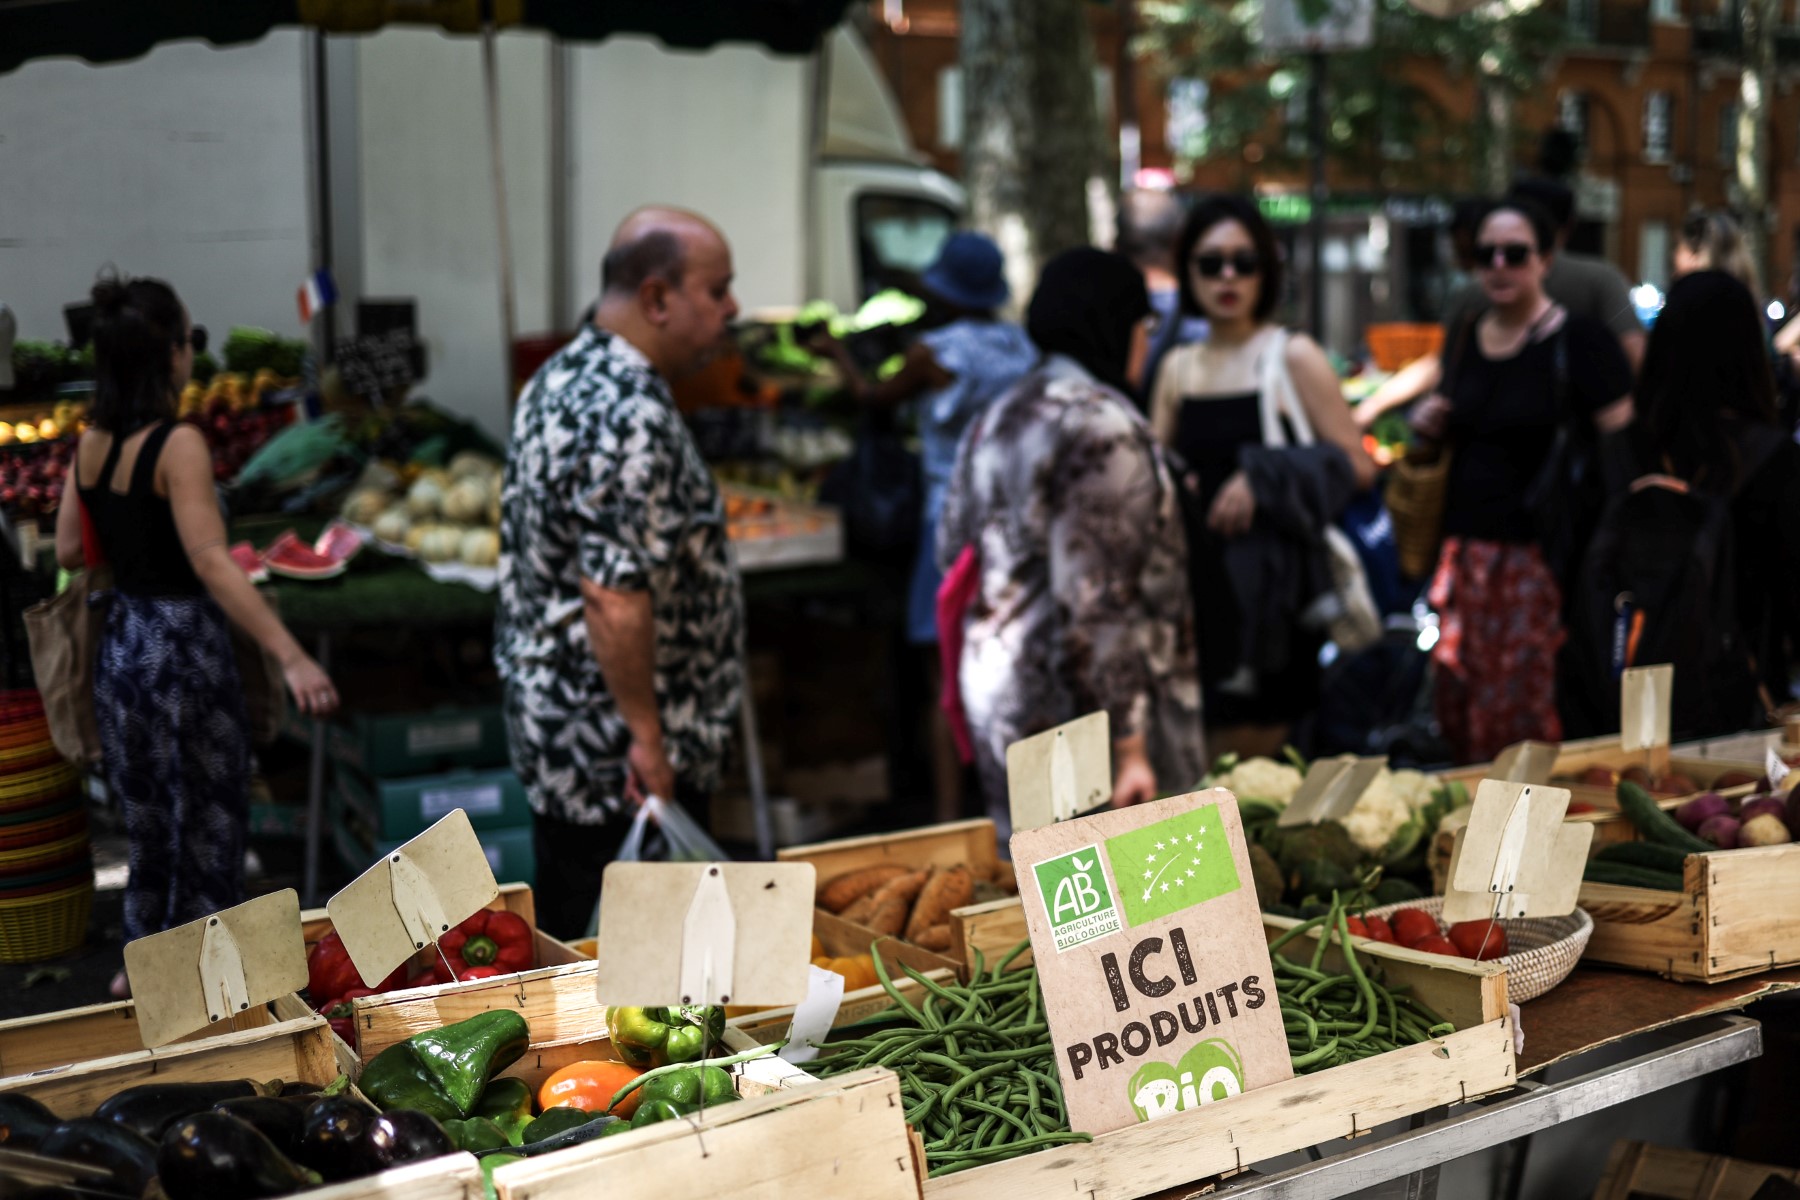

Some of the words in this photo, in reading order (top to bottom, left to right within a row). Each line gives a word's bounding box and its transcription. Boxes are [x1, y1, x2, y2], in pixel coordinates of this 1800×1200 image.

[1053, 872, 1100, 923] AB
[1054, 909, 1116, 937] AGRICULTURE
[1057, 919, 1120, 948] BIOLOGIQUE
[1100, 927, 1197, 1012] ICI
[1067, 975, 1266, 1080] PRODUITS
